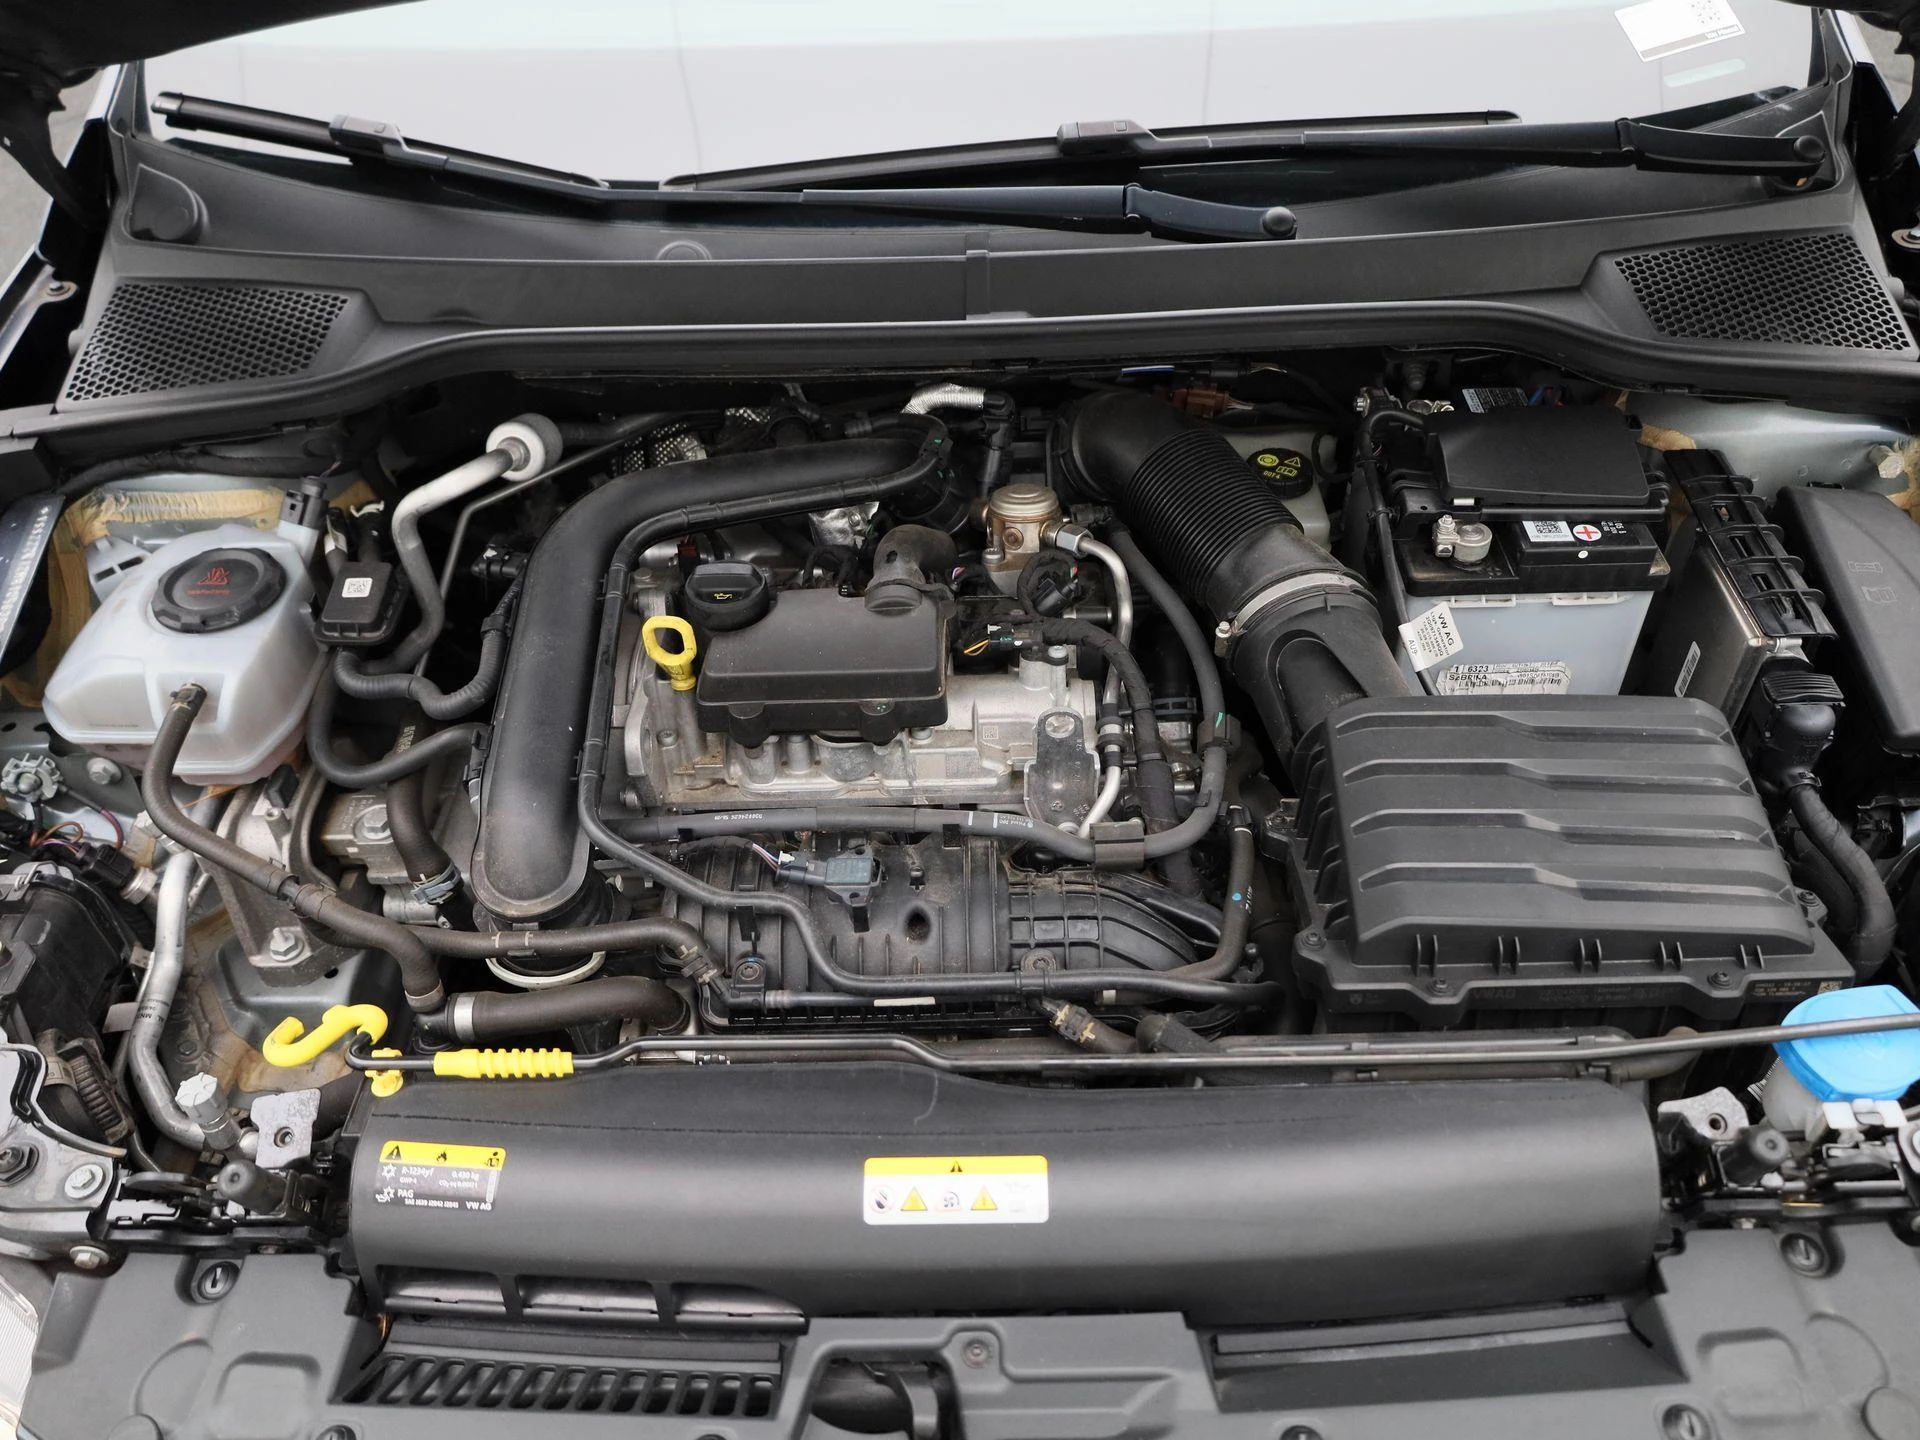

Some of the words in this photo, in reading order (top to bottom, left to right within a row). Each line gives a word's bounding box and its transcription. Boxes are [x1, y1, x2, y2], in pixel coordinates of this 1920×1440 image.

[1438, 612, 1448, 629] VW
[1444, 631, 1455, 646] AG
[1467, 665, 1490, 674] 6323
[397, 1189, 414, 1198] PAG
[466, 1201, 479, 1210] VW
[480, 1202, 492, 1211] AG
